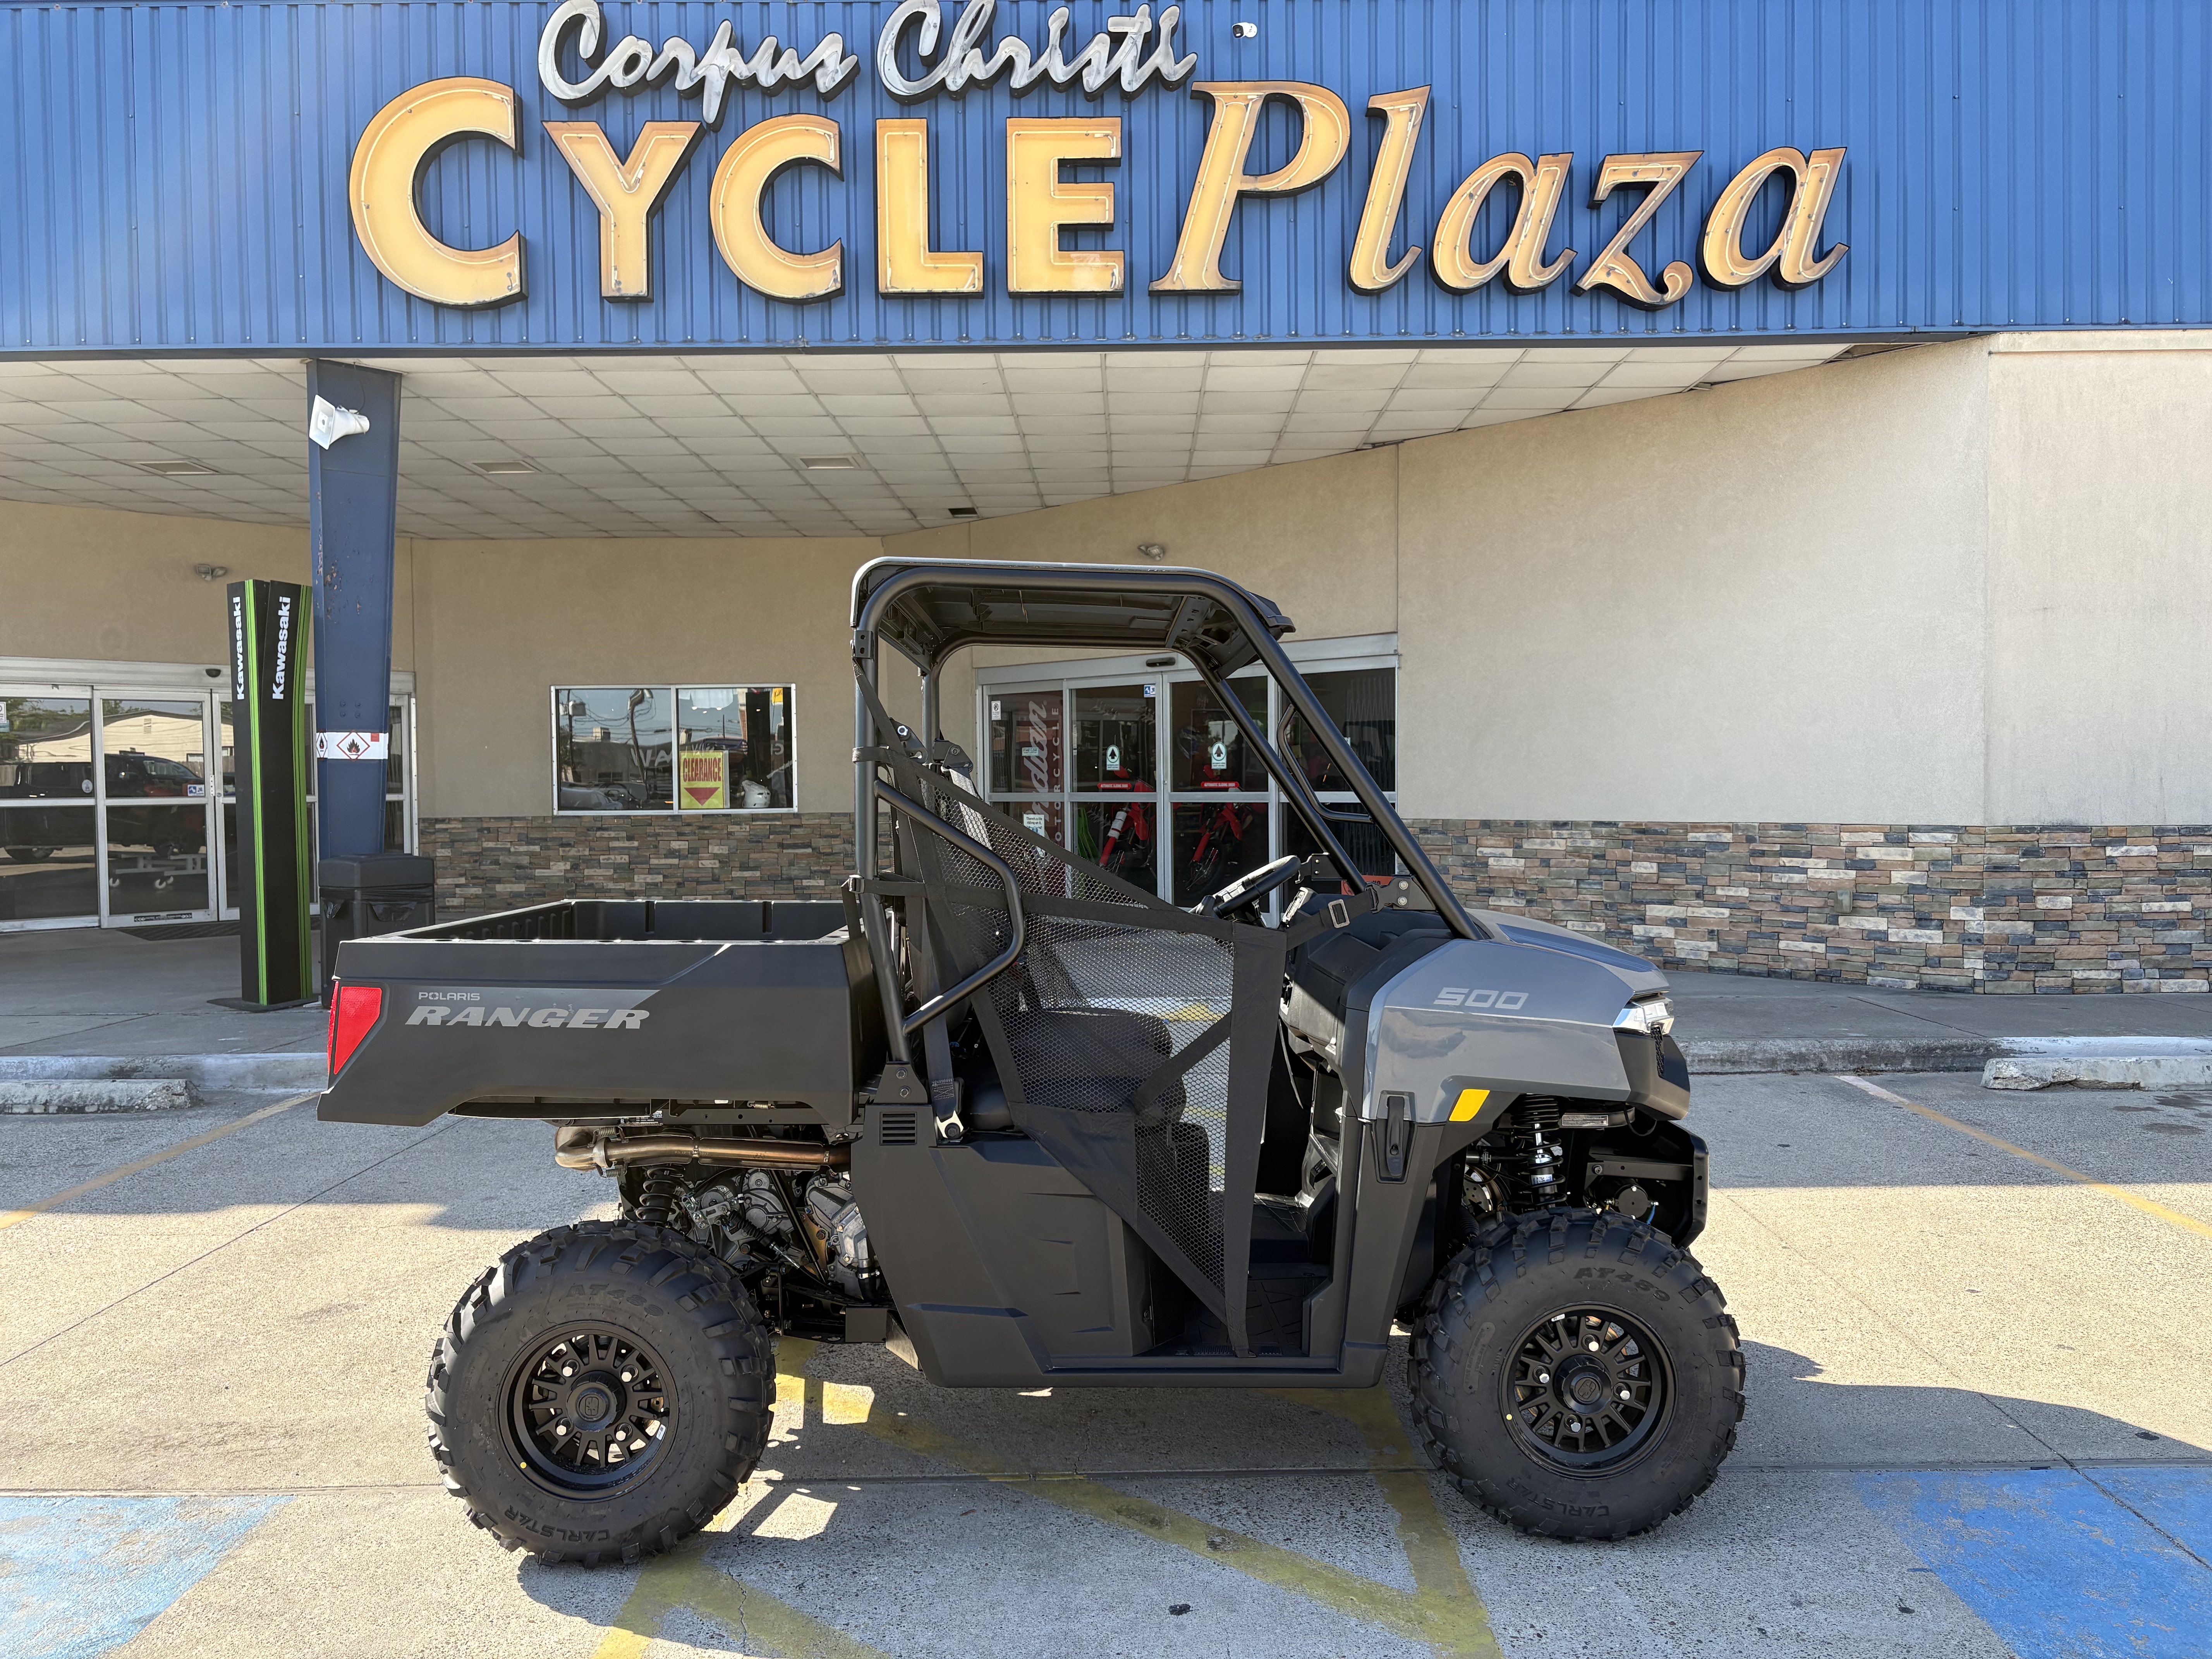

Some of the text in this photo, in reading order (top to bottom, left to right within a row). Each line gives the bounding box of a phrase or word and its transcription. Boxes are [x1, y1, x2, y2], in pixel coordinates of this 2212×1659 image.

[539, 0, 1198, 130] Corpus Christi
[350, 76, 1849, 311] CYCLE Plaza
[233, 596, 244, 700] Kawasaki
[272, 596, 291, 700] Kawasaki
[683, 757, 721, 782] CLEARANCE
[418, 992, 480, 1001] POLARIS
[1433, 987, 1529, 1010] 500
[405, 1006, 650, 1029] RANGER
[566, 1283, 664, 1317] AT489
[1574, 1267, 1671, 1302] AT489
[1505, 1477, 1610, 1518] CARLSTAR
[504, 1504, 610, 1543] CARLSTAR
